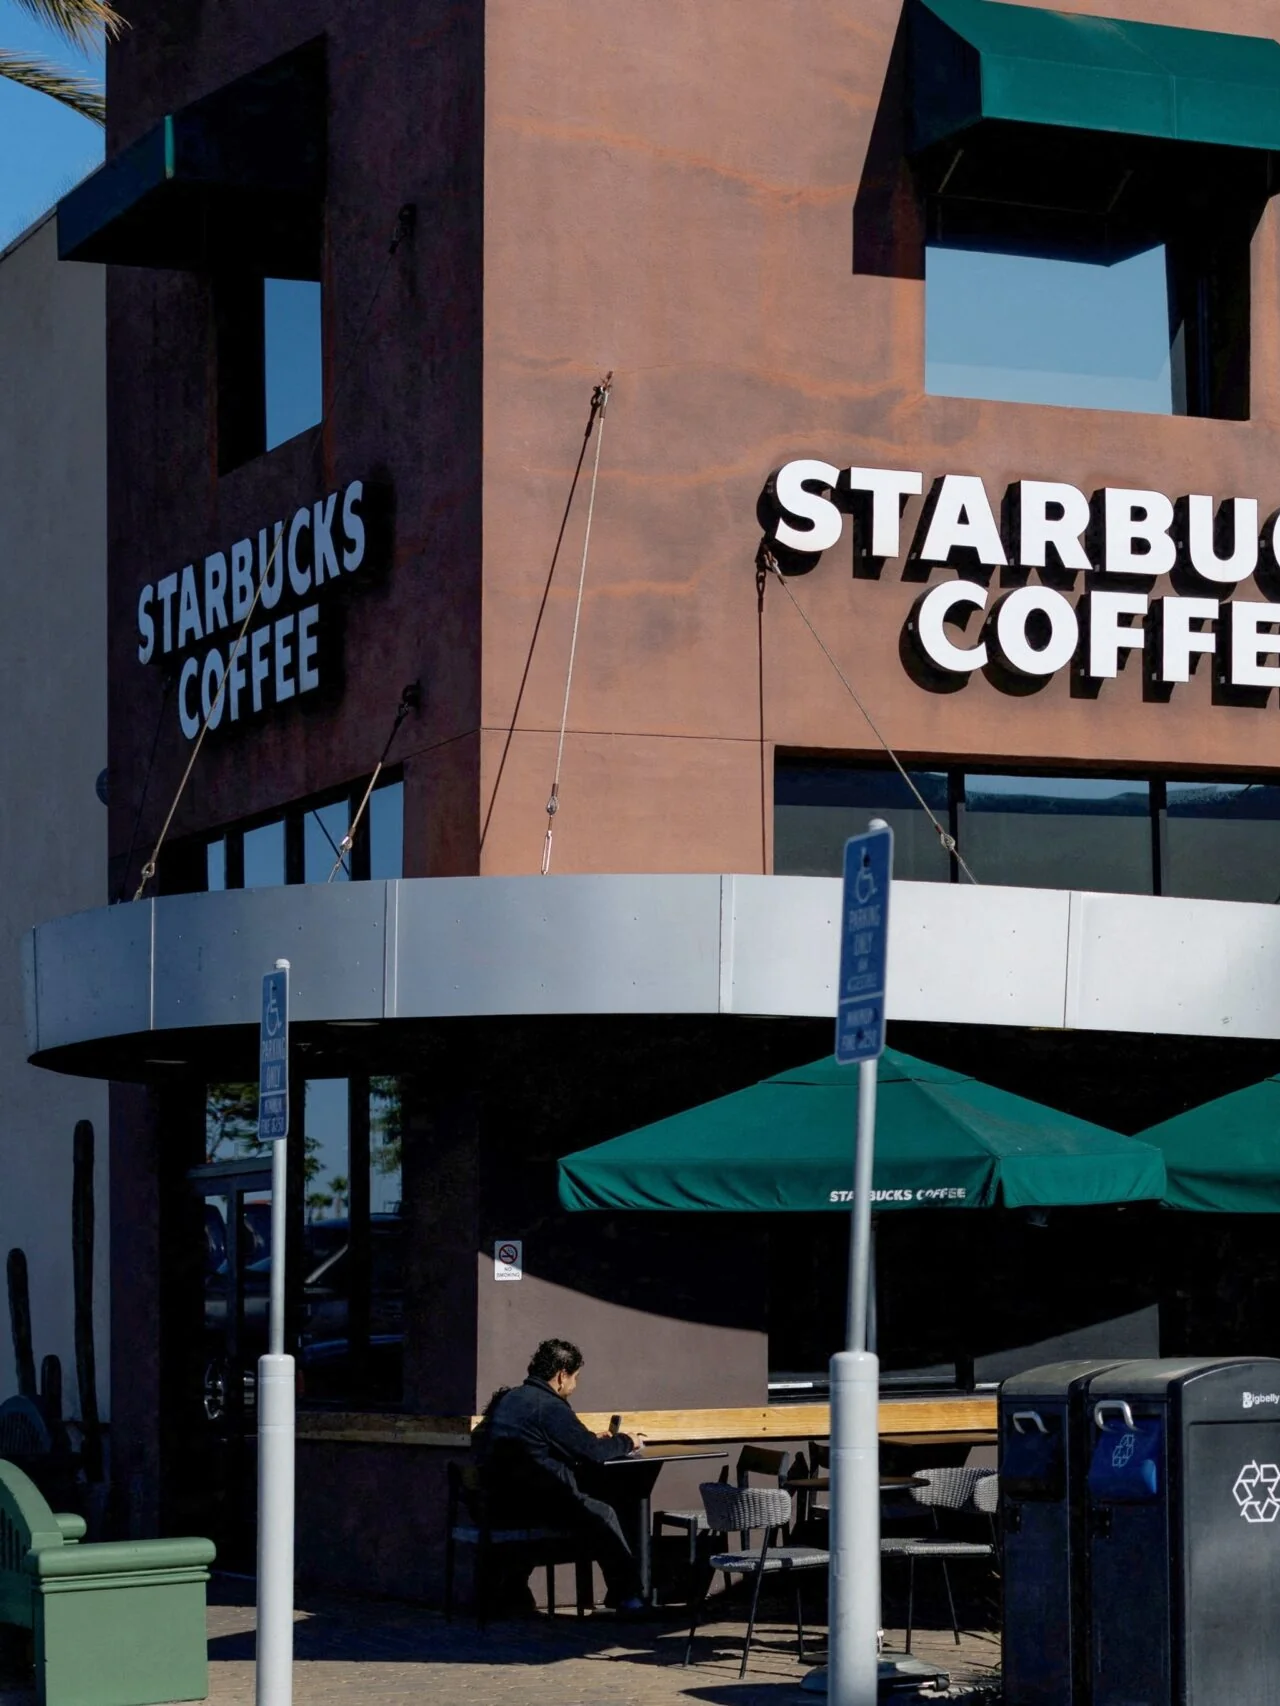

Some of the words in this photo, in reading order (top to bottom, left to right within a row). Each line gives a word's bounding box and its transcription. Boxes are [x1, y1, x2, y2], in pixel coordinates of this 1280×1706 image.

[137, 480, 365, 665] STARBUCKS
[178, 603, 319, 740] COFFEE
[829, 1189, 913, 1202] STABUCKS
